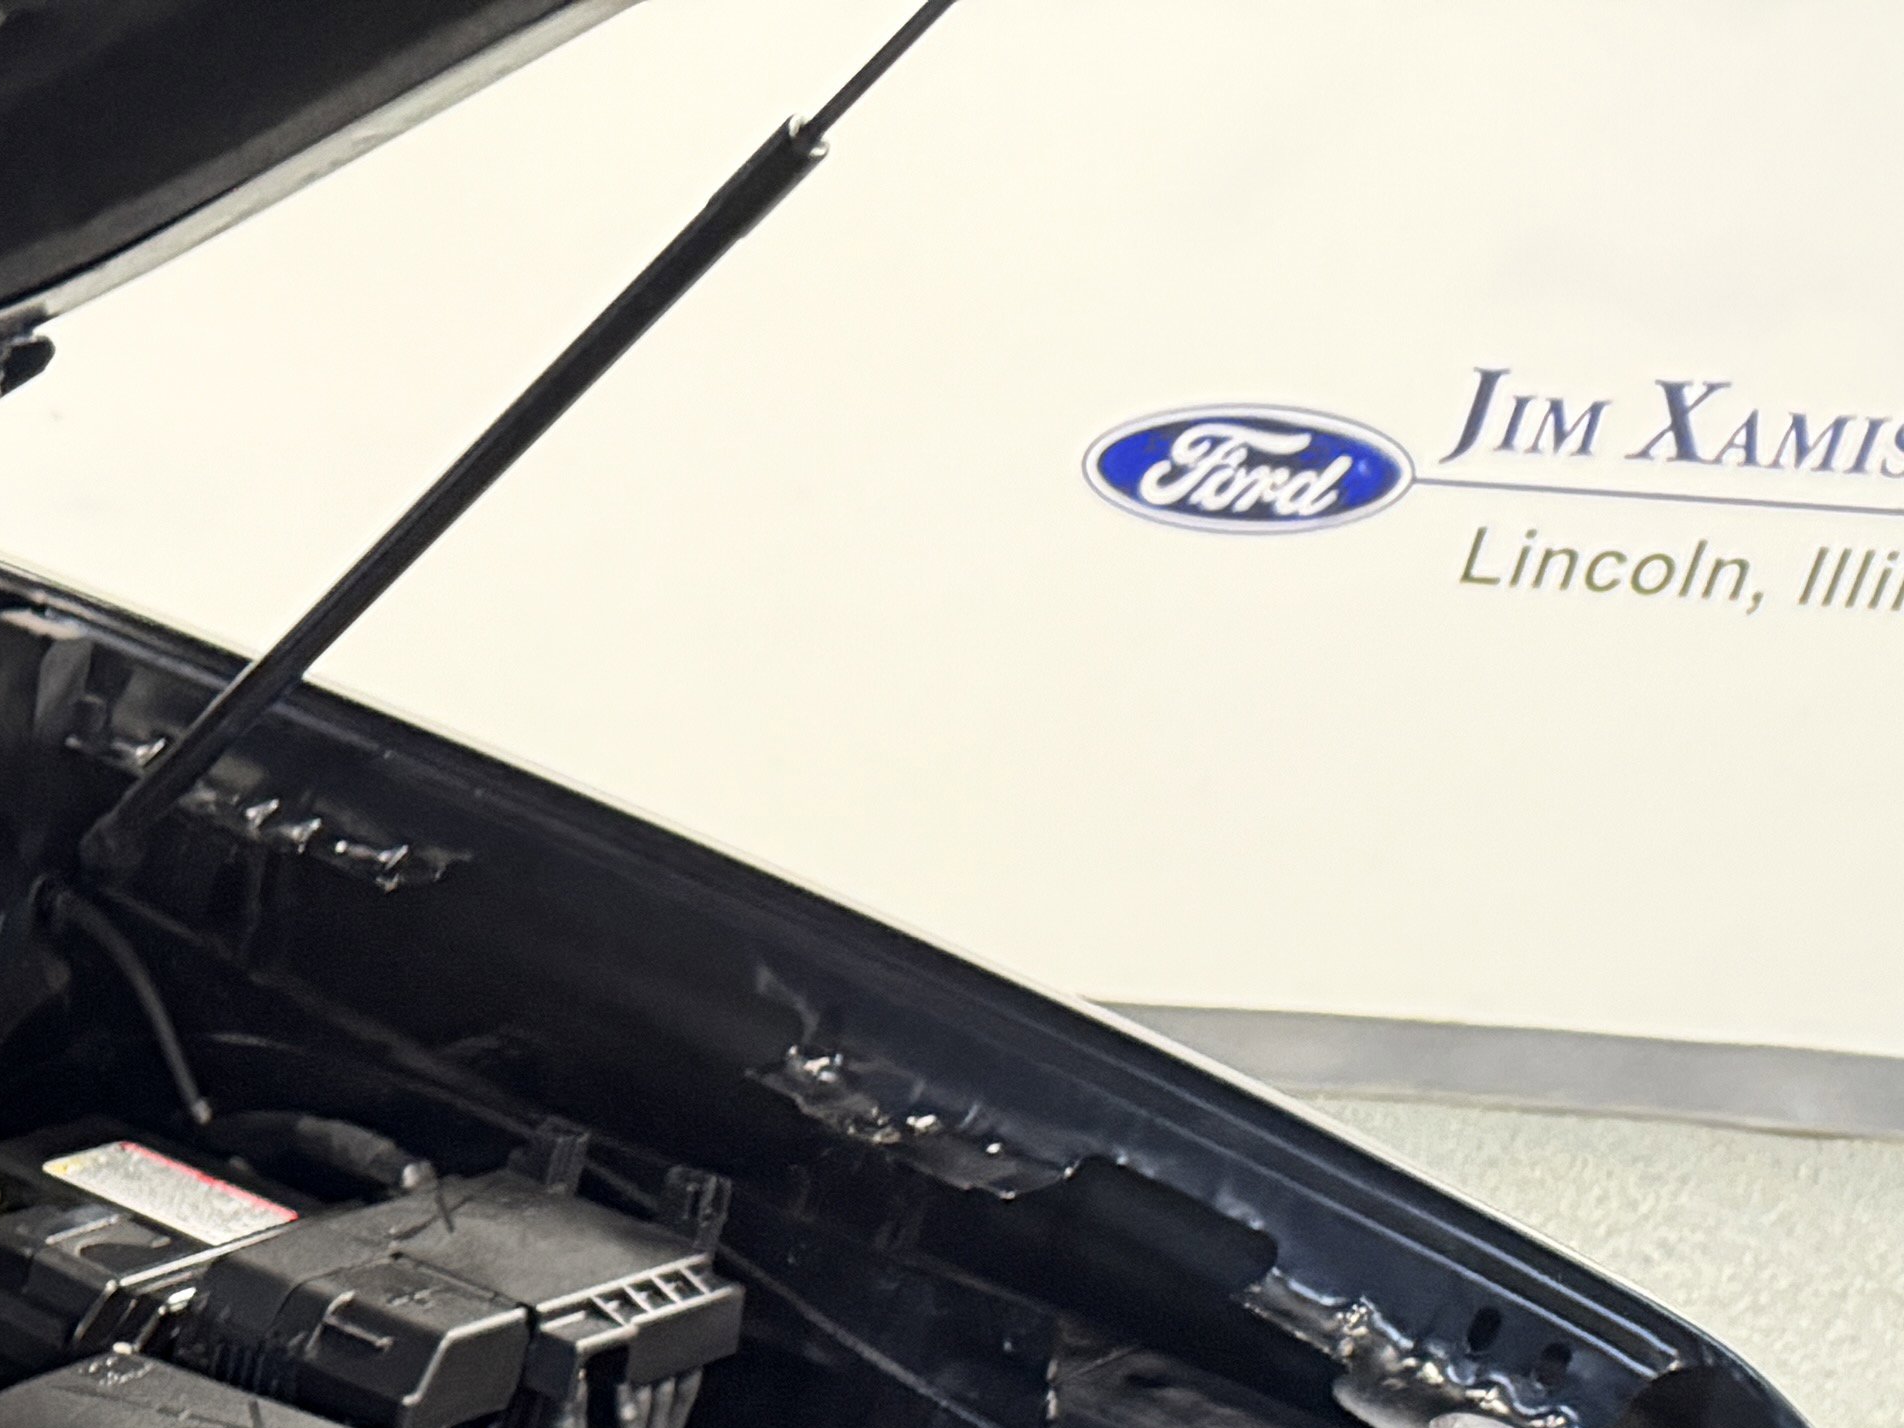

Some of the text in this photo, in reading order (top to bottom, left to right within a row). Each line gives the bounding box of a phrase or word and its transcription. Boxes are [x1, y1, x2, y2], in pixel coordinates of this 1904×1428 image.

[1439, 367, 1612, 463] JIM
[1139, 422, 1356, 517] Ford
[1459, 526, 1904, 615] Lincoln, Illi
